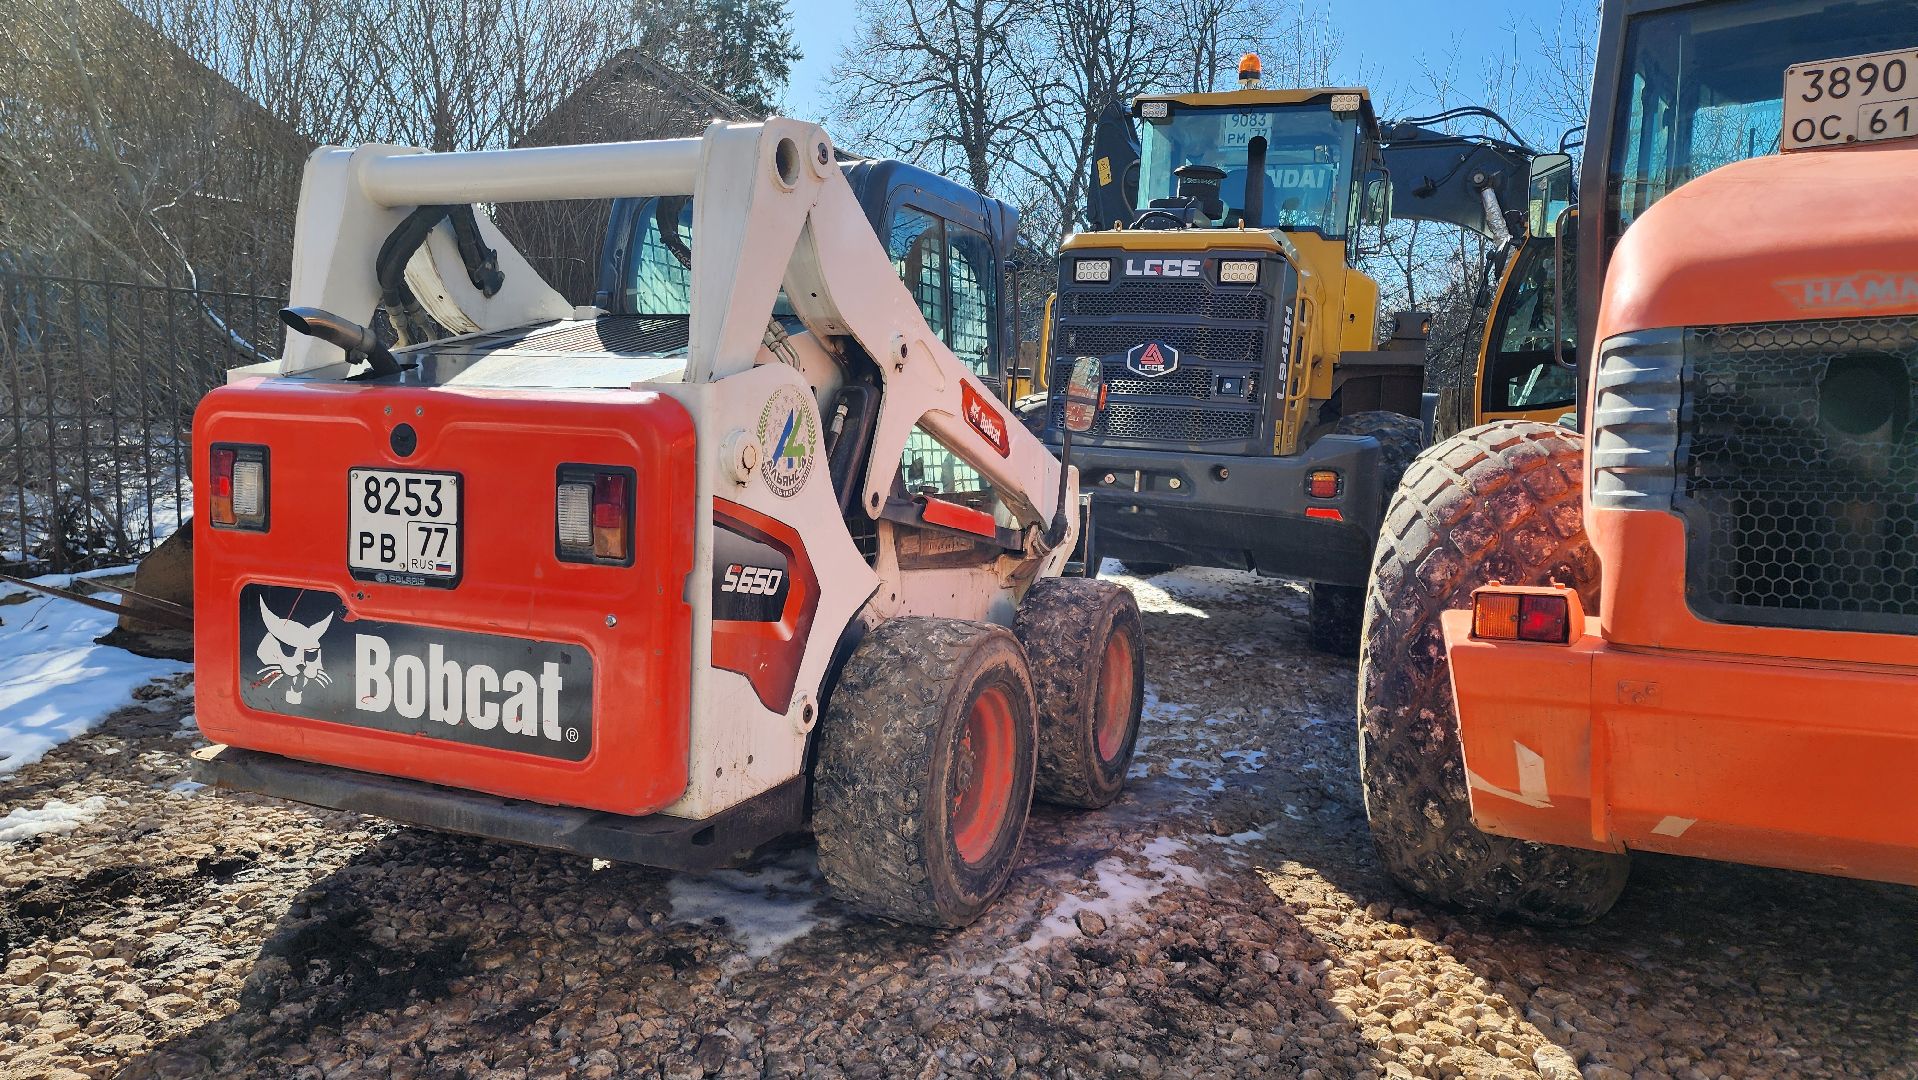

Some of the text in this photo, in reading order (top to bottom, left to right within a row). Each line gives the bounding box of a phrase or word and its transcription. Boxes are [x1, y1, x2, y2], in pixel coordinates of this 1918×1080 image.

[1801, 59, 1907, 103] 3890
[1231, 114, 1266, 127] 9083
[1792, 105, 1910, 143] ОС 61
[1266, 169, 1326, 188] NDAI
[979, 411, 1001, 446] Bobcat
[363, 475, 443, 518] 8253
[359, 526, 449, 563] РВ 77
[411, 558, 434, 571] RUS
[721, 564, 783, 596] S650
[355, 633, 563, 742] Bobcat
